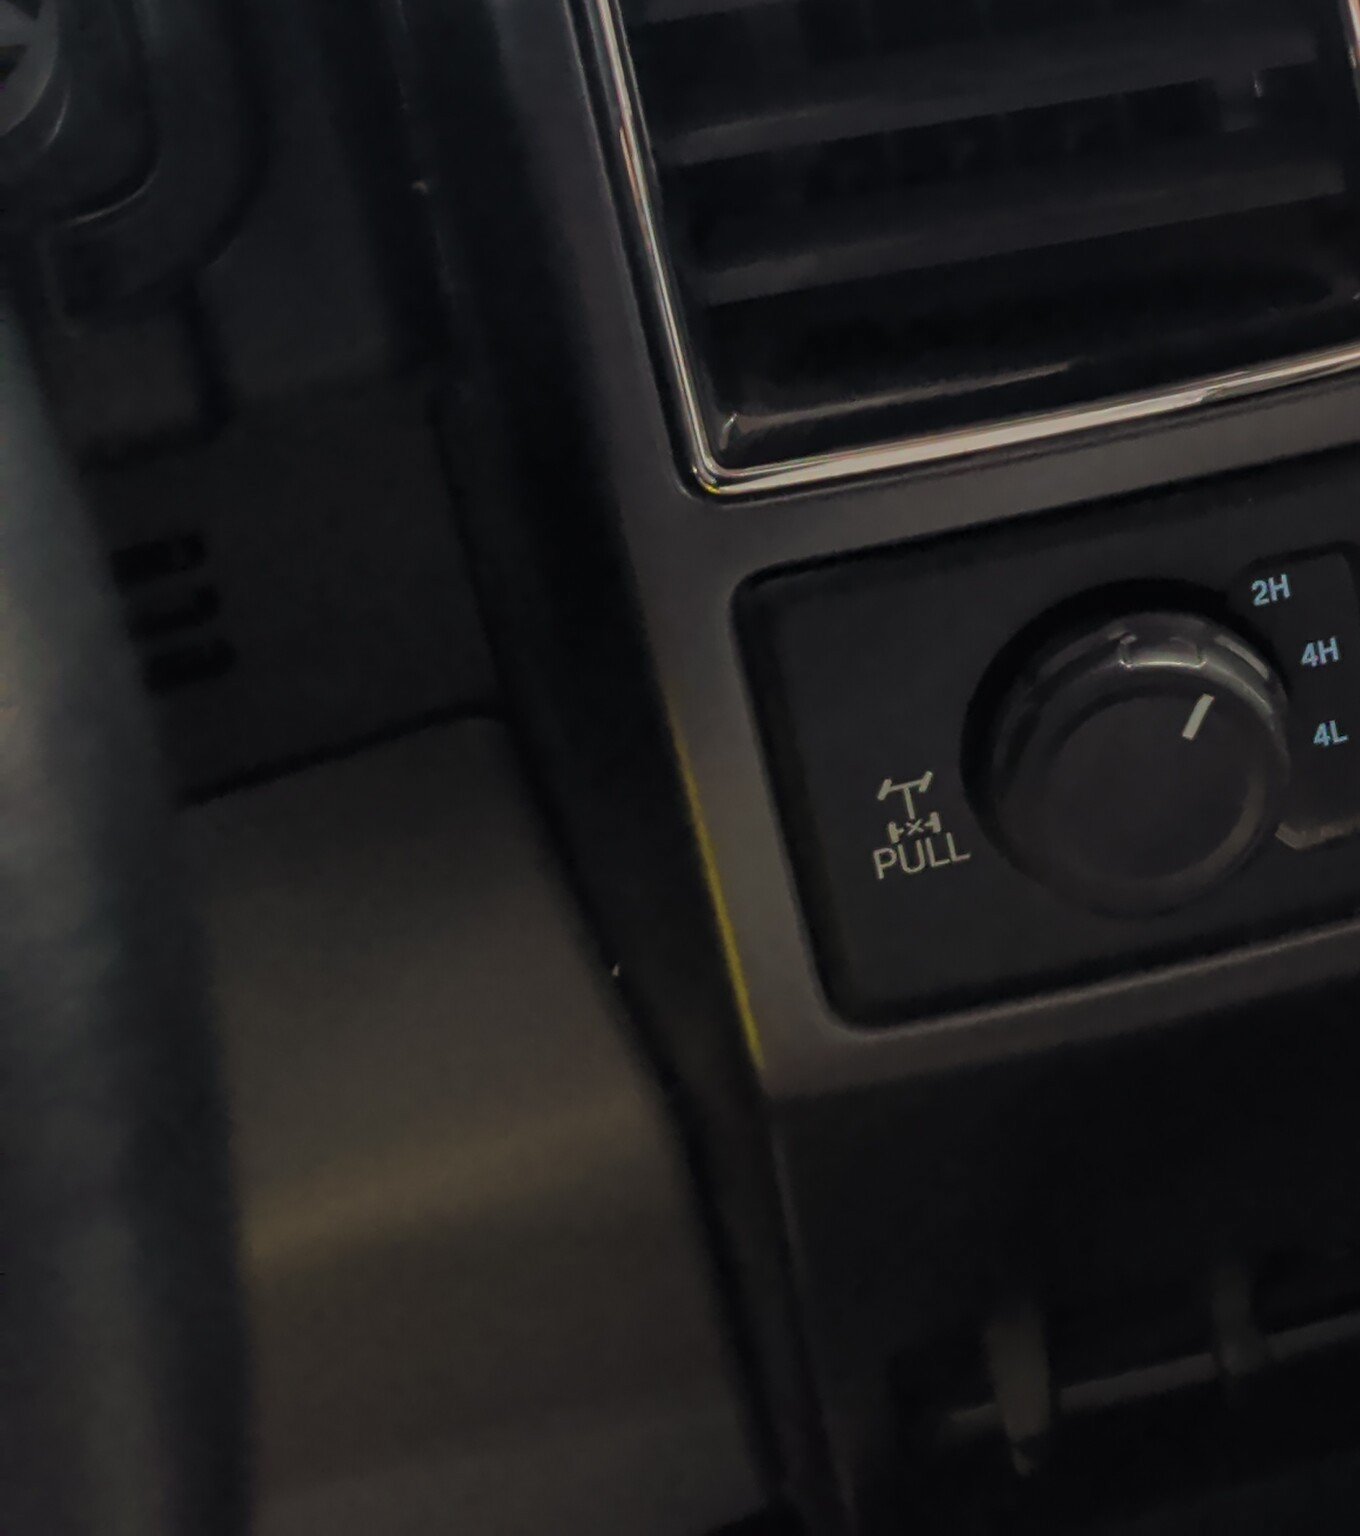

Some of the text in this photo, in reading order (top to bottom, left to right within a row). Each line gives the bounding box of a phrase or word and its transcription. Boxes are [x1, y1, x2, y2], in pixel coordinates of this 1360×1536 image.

[1251, 573, 1291, 607] 2H
[1301, 636, 1340, 667] 4H
[1313, 719, 1349, 746] 4L
[873, 831, 971, 880] PULL
